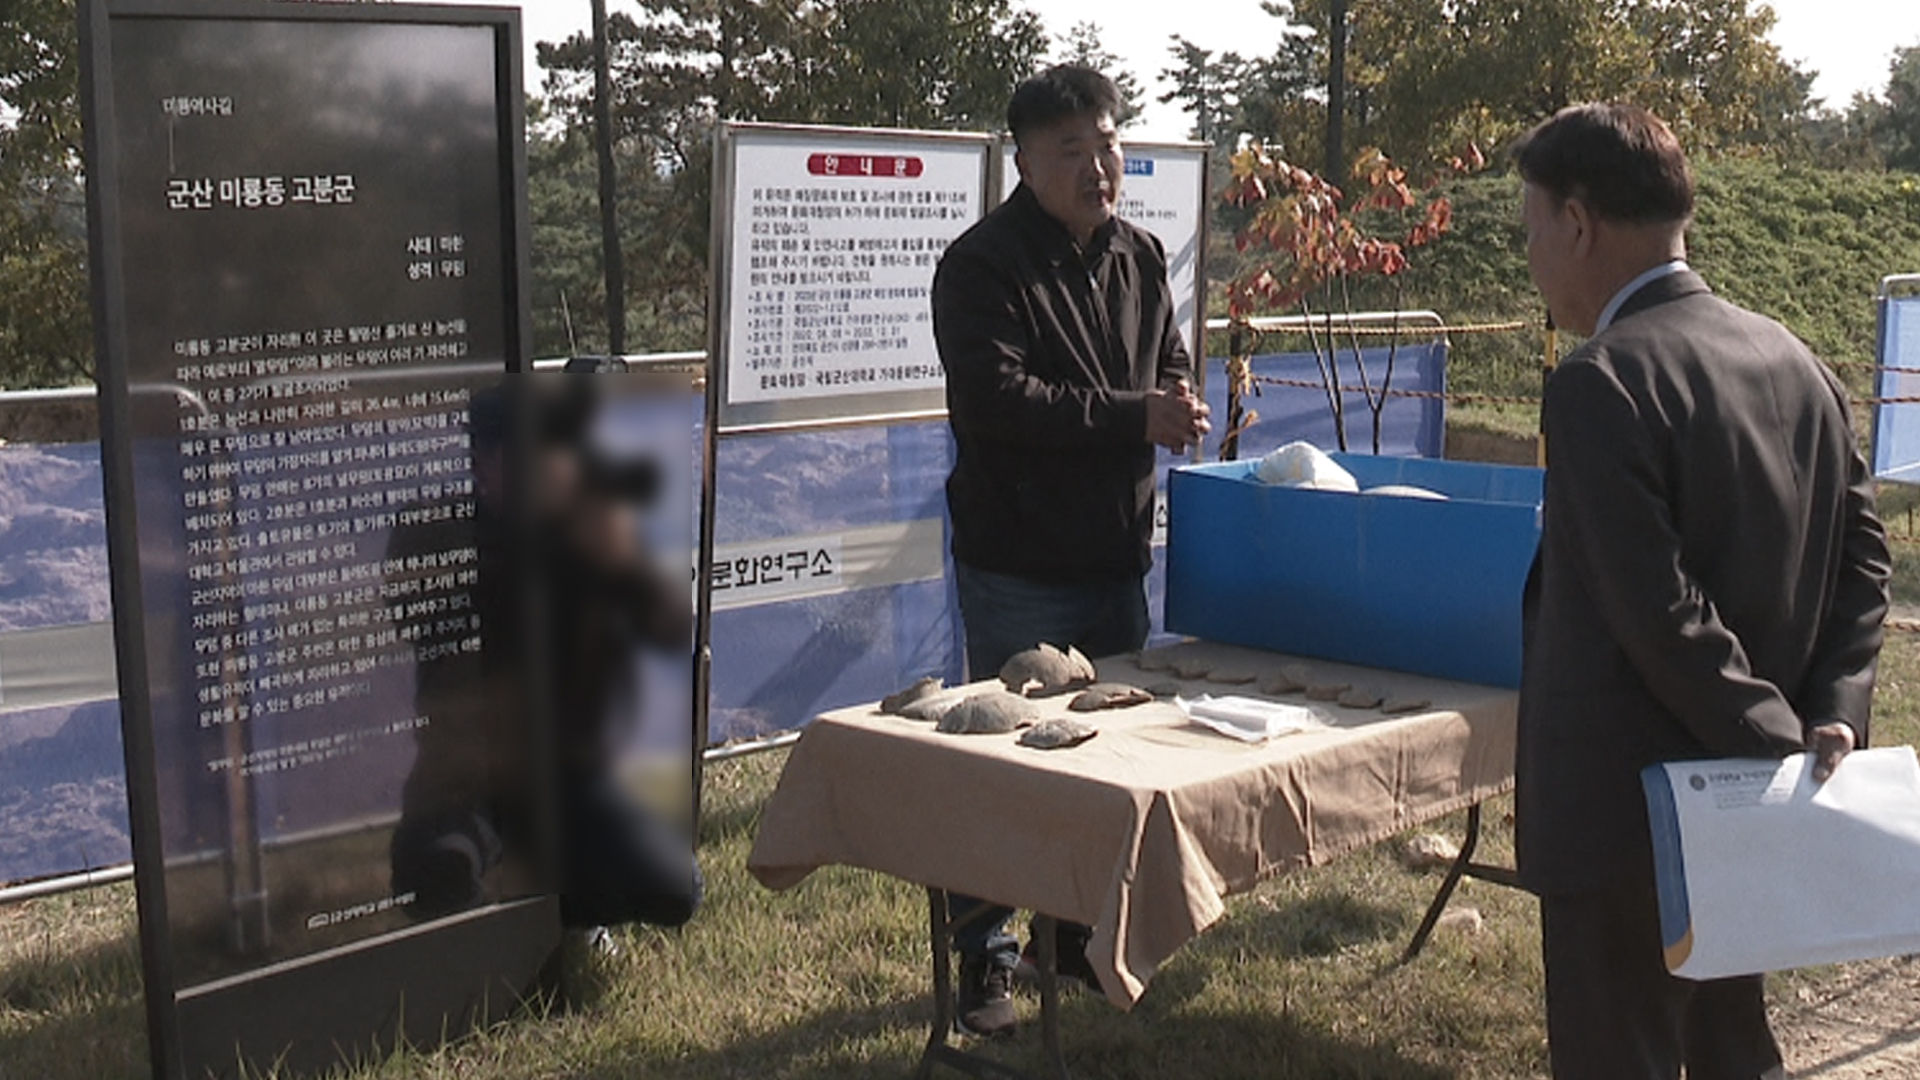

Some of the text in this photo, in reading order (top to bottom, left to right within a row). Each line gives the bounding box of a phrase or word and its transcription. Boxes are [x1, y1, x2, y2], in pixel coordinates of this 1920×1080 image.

[163, 96, 233, 116] 미룡역사길
[824, 156, 906, 175] 안 내 문
[166, 174, 355, 209] 군산 미룡동 고분군
[408, 235, 464, 255] 시대 마한
[408, 260, 465, 279] 성격 무덤
[172, 337, 210, 357] 미룡동
[214, 333, 263, 353] 고분군이
[265, 330, 302, 349] 자리한
[304, 329, 316, 346] 이
[321, 327, 343, 345] 곳은
[176, 363, 200, 381] 따라
[201, 359, 250, 378] 예로부터
[355, 347, 389, 365] 무덤이
[389, 345, 411, 362] 여러
[301, 401, 335, 420] 자리한
[225, 431, 271, 452] 무덤으로
[350, 419, 383, 438] 무덤의
[690, 548, 832, 591] 문화연구소
